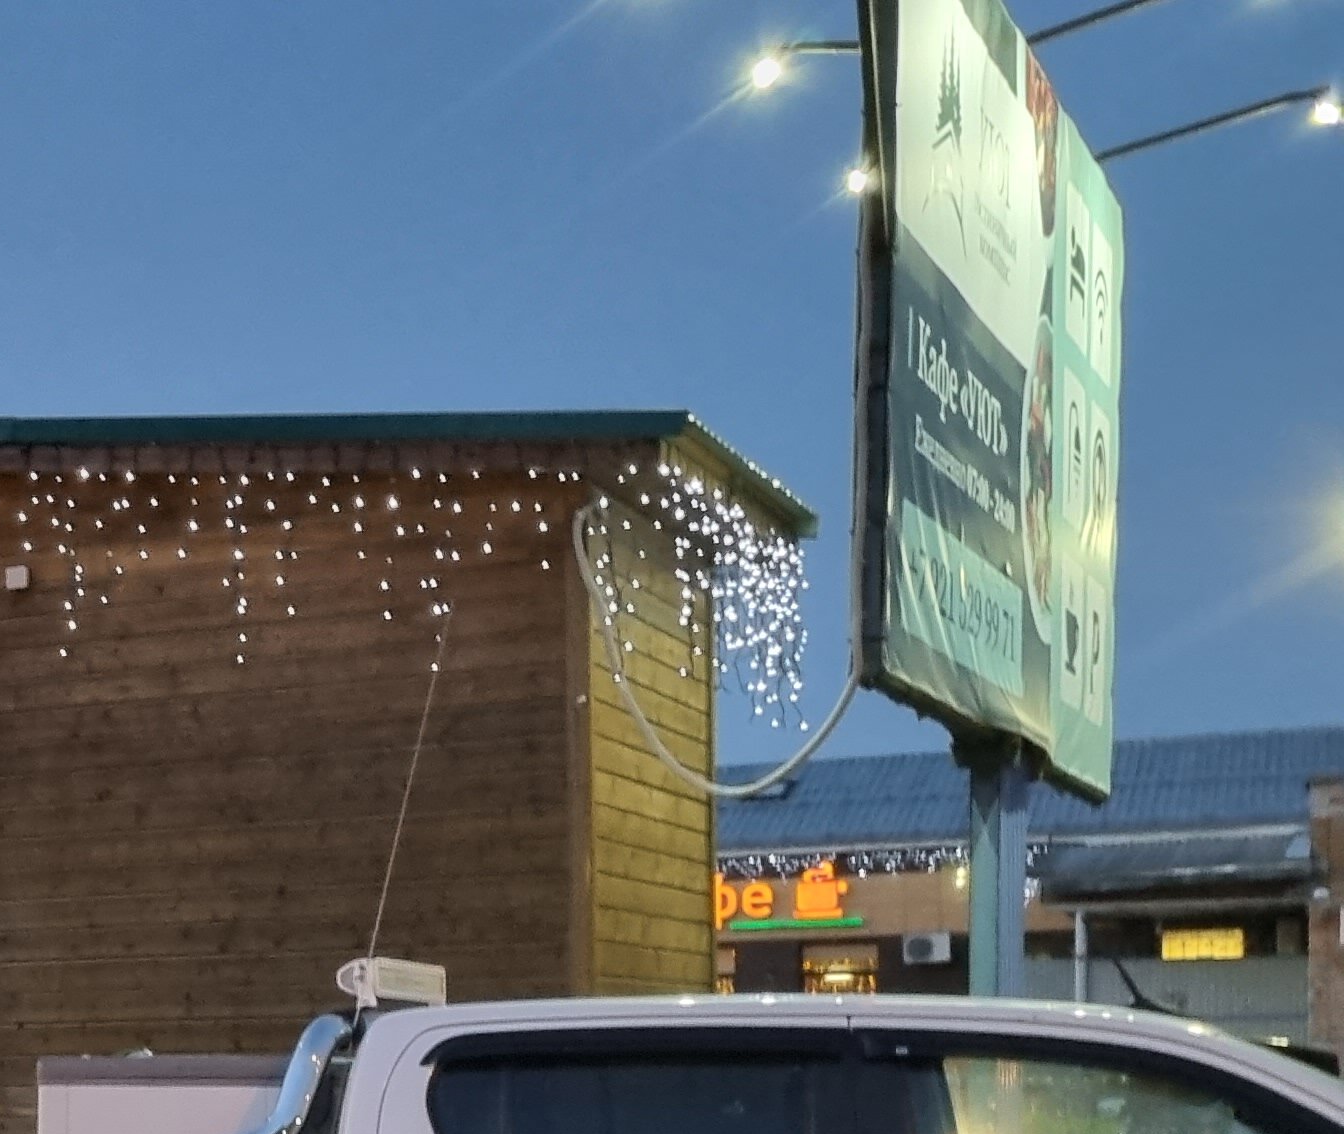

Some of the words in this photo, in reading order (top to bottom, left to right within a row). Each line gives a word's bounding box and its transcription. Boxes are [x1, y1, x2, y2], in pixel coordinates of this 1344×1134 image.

[917, 315, 959, 424] Кафе
[960, 370, 1008, 456] «УЮТ»
[930, 557, 955, 623] 921
[985, 596, 1000, 650] 99
[1002, 608, 1015, 662] 71
